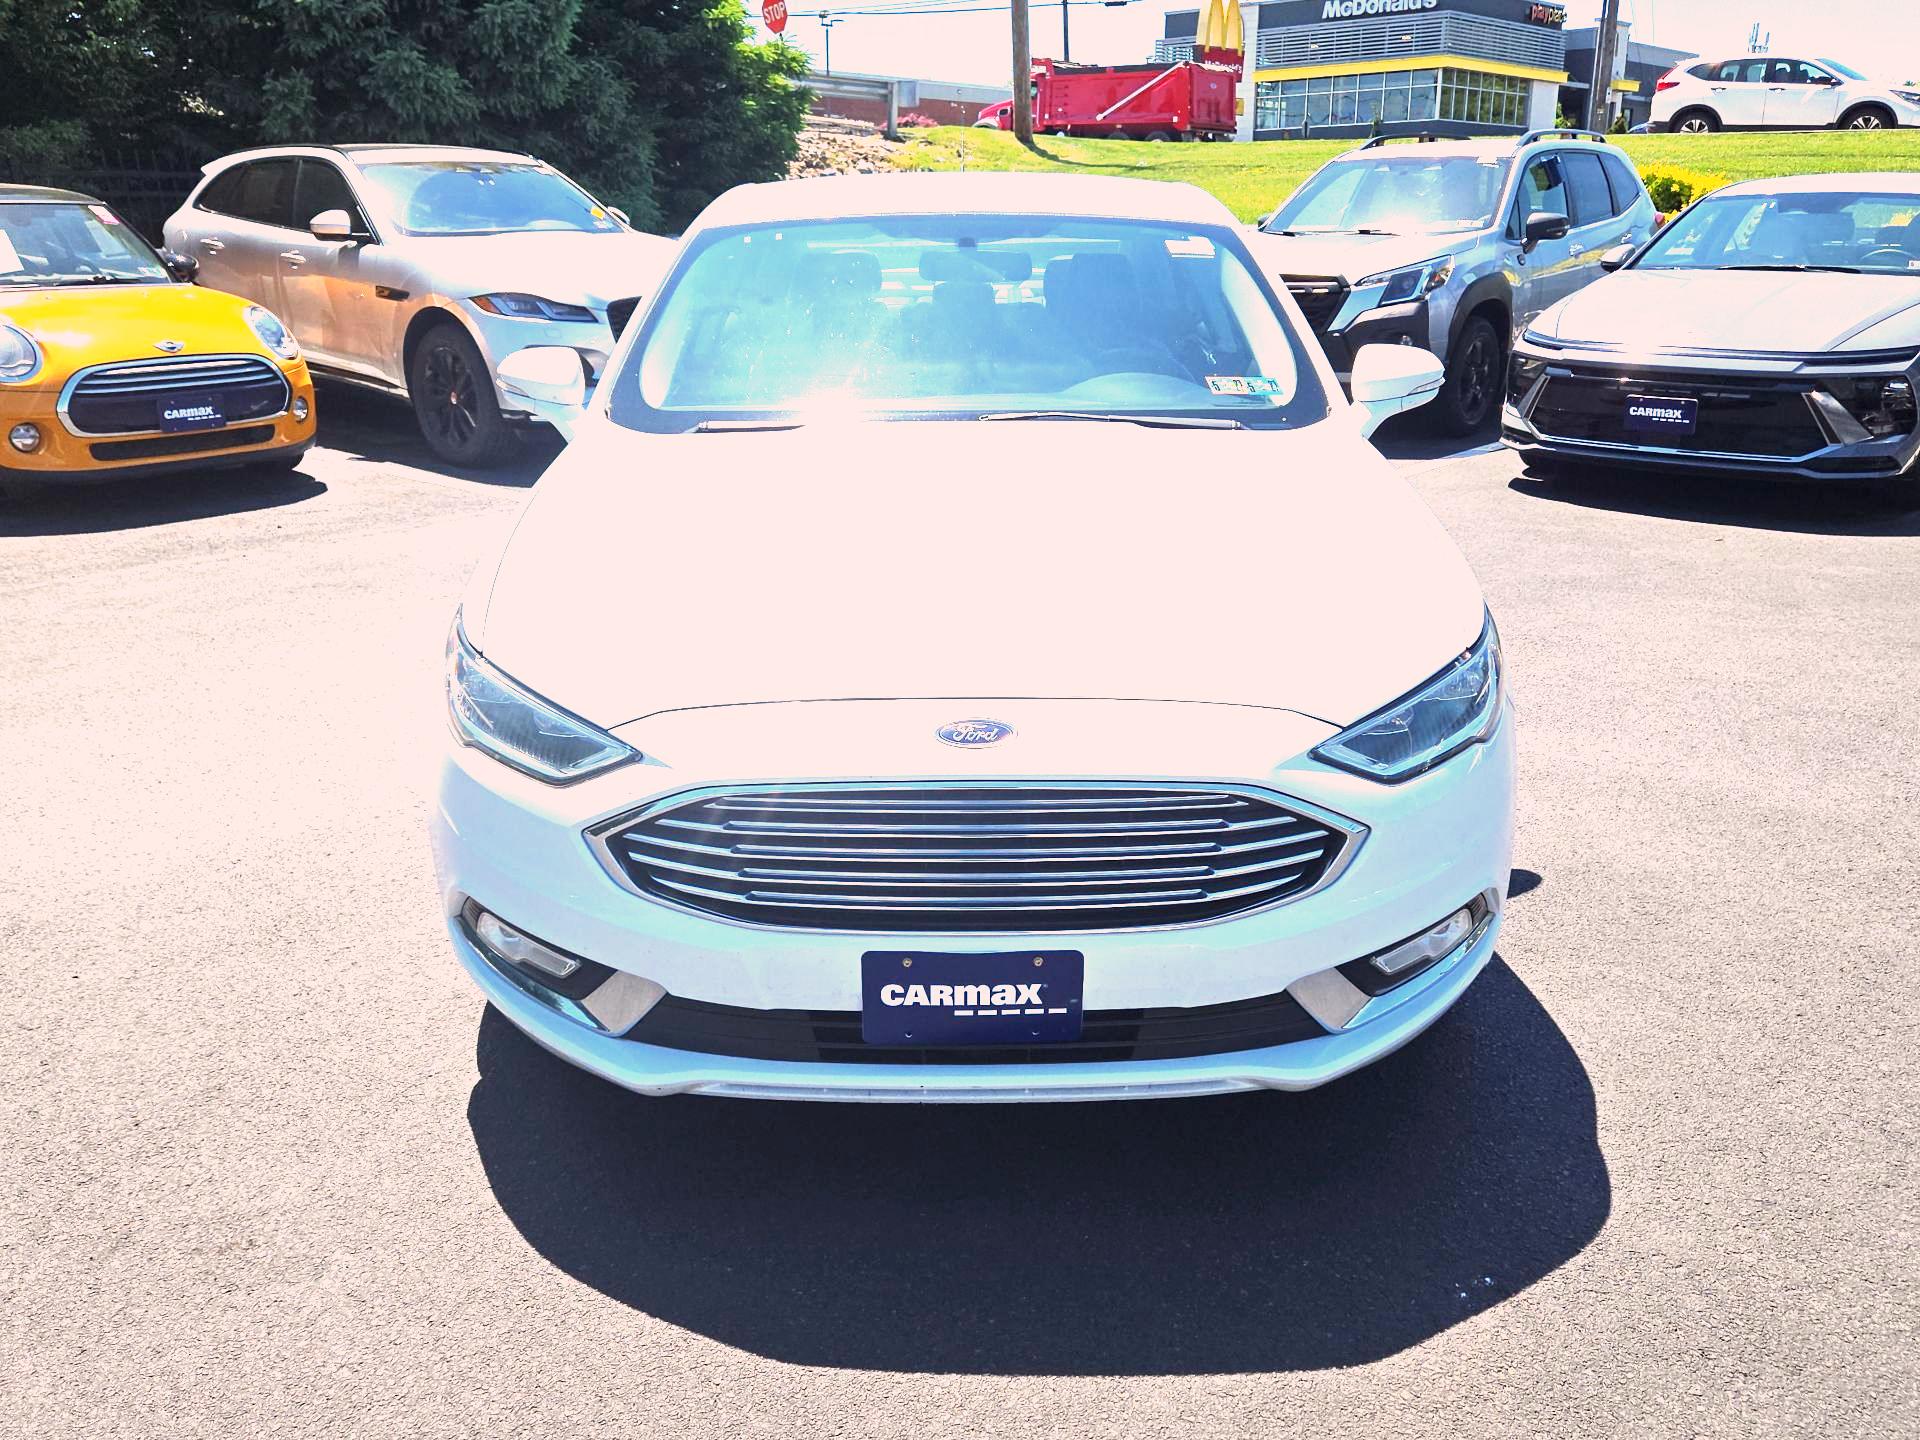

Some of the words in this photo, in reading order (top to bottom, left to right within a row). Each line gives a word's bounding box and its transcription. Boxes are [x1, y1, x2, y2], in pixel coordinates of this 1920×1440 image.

[764, 2, 785, 24] STOP
[1321, 0, 1438, 19] McDonalds
[952, 723, 1000, 742] Ford
